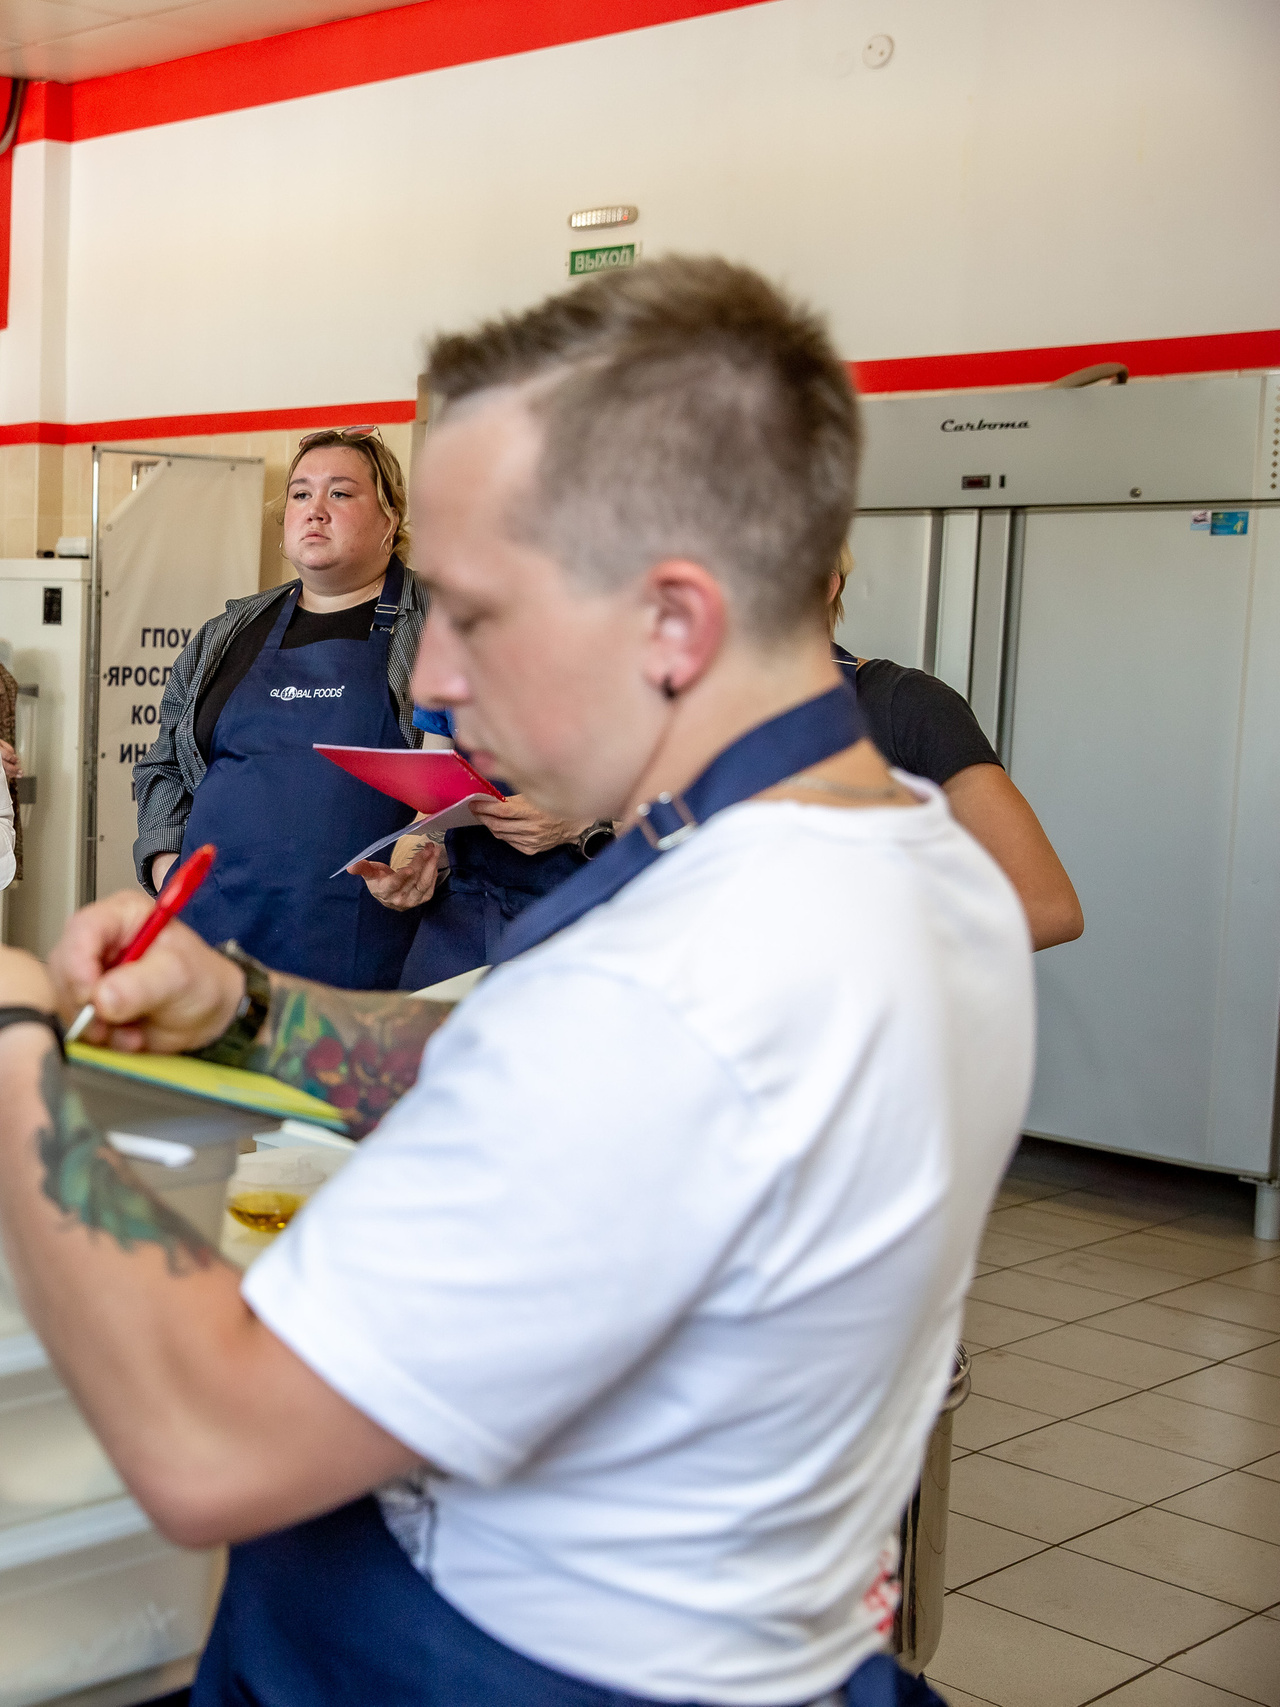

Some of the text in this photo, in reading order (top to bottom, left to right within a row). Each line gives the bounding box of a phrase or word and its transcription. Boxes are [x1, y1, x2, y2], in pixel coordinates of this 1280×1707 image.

[574, 248, 632, 272] ВЫХОД
[940, 418, 1030, 433] Carboma
[141, 627, 192, 648] ГПОУ
[131, 705, 162, 725] КО
[120, 743, 153, 763] ИН
